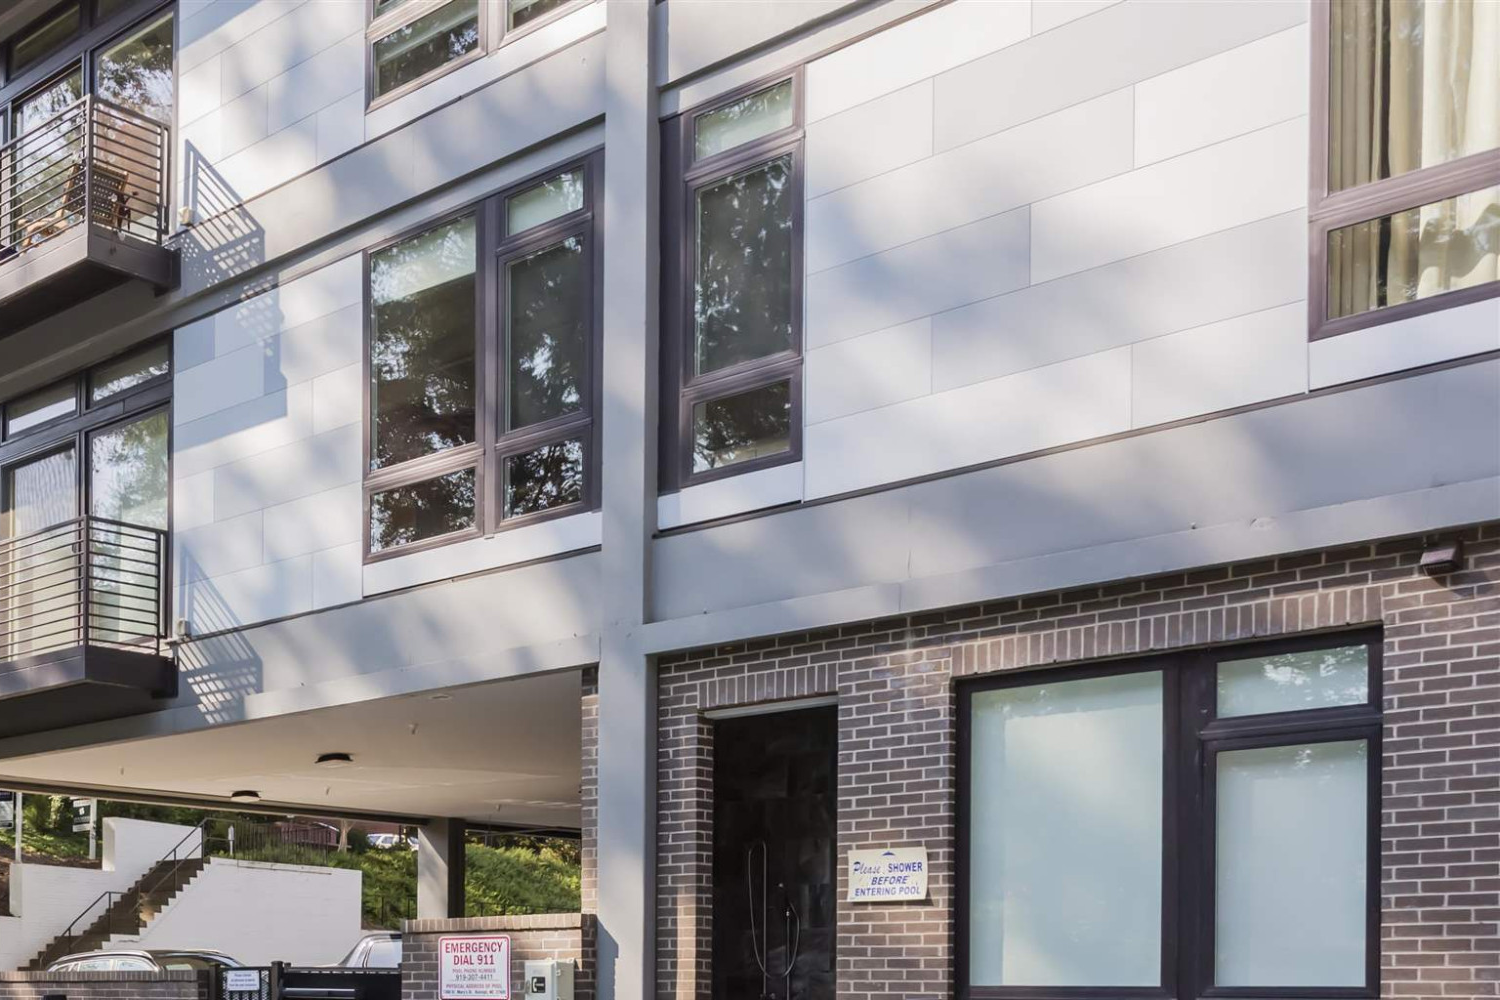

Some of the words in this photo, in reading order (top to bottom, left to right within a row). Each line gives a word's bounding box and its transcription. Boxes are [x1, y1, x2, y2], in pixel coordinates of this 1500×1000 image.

[853, 861, 881, 875] Please
[888, 862, 923, 873] SHOWER
[871, 875, 909, 885] BEFORE
[855, 887, 897, 896] ENTERING
[899, 886, 921, 894] POOL
[445, 942, 503, 953] EMERGENCY
[453, 955, 475, 965] DIAL
[477, 954, 495, 965] 911
